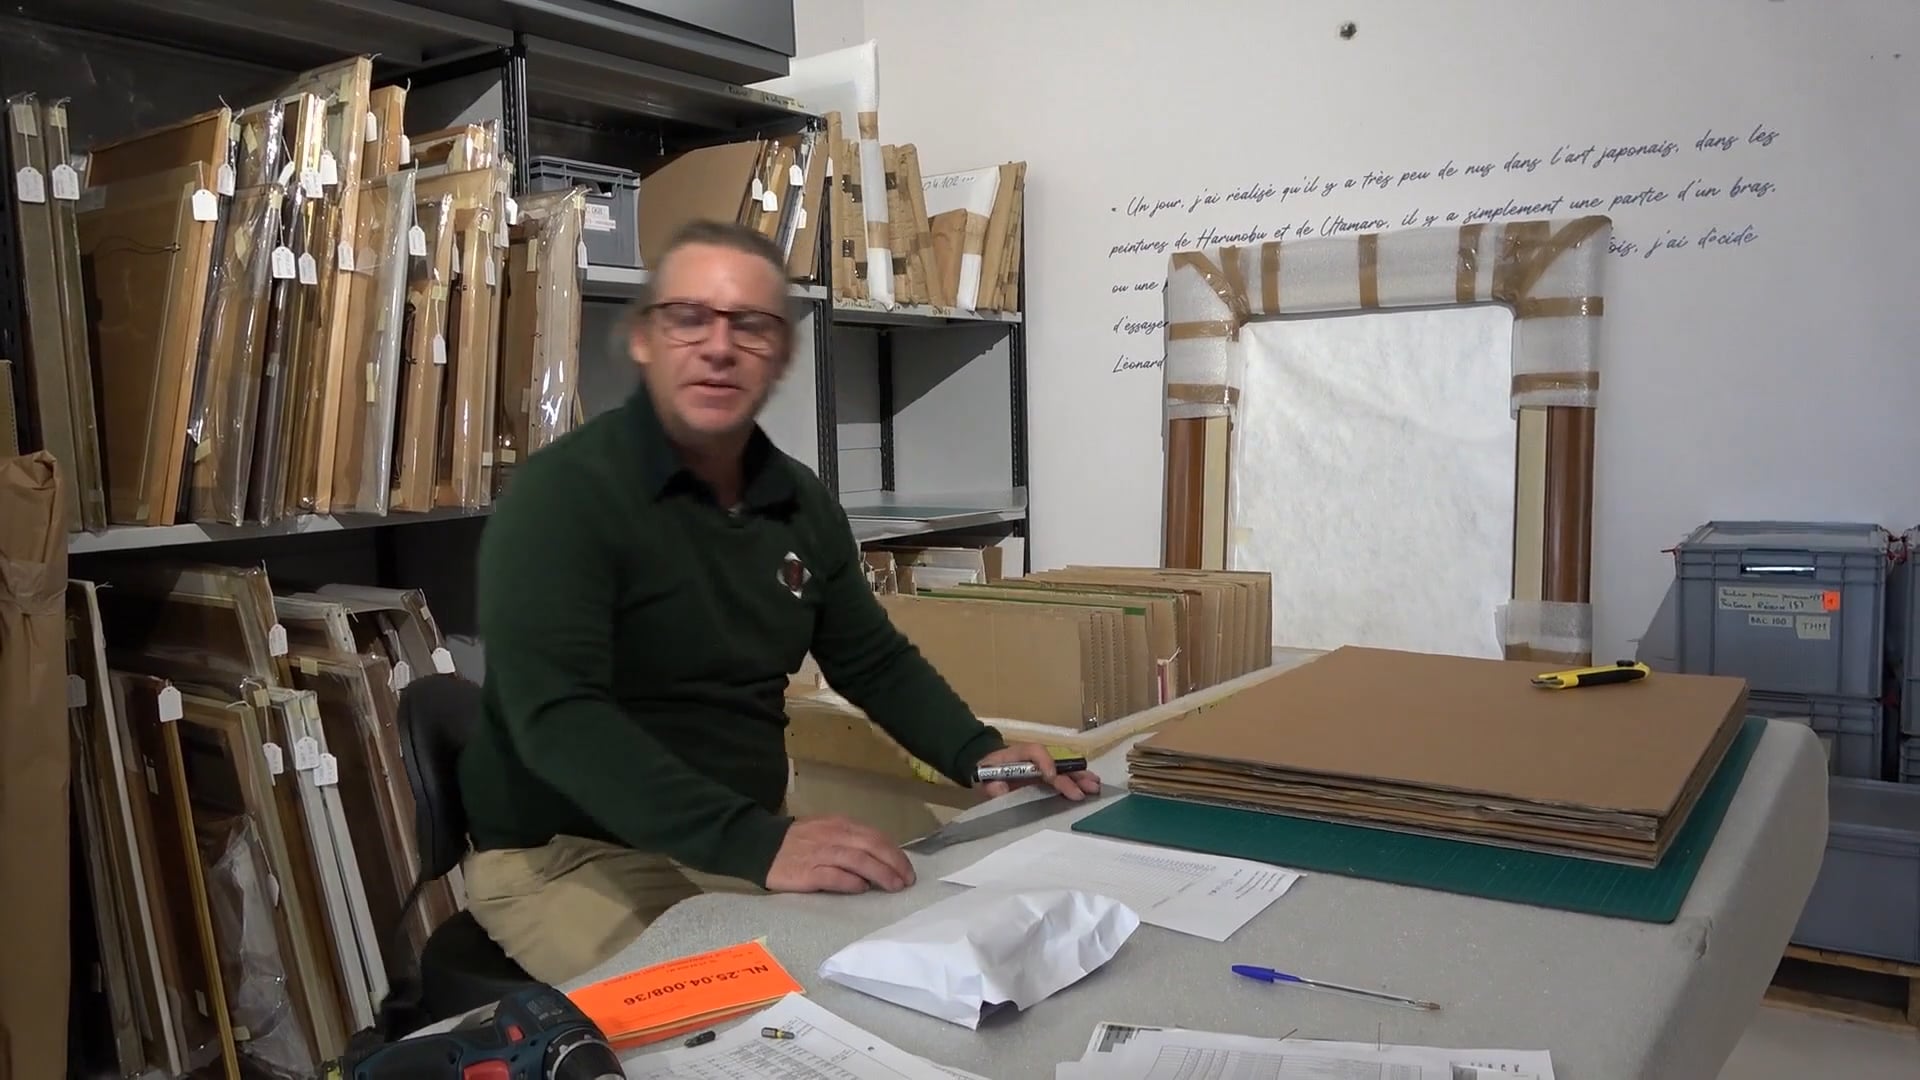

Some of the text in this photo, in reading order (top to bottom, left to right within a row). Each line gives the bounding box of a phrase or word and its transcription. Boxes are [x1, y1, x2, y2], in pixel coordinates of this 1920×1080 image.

[1127, 196, 1150, 217] Un
[1188, 187, 1221, 213] j'ai
[1226, 182, 1277, 203] réalisé
[1281, 176, 1321, 203] qu'il
[1321, 182, 1338, 197] y
[1344, 179, 1357, 189] a
[1361, 170, 1395, 189] très
[1397, 171, 1431, 187] peu
[1437, 160, 1459, 180] de
[1464, 163, 1496, 178] nus
[1503, 151, 1543, 173] dans
[1549, 144, 1596, 169] l'art
[1695, 129, 1739, 151] dans
[1748, 123, 1780, 147] les
[1108, 238, 1169, 259] peintures
[1174, 231, 1192, 248] de
[1197, 225, 1268, 249] Harunobu
[1273, 223, 1292, 240] et
[1295, 219, 1314, 239] de
[1401, 208, 1420, 227] il
[1421, 215, 1440, 228] y
[1445, 212, 1460, 222] a
[1462, 195, 1564, 224] simplement
[1569, 197, 1604, 210] une
[1607, 187, 1668, 212] partie
[1677, 178, 1721, 201] d'un
[1111, 284, 1129, 294] ou
[1134, 281, 1159, 291] une
[1608, 238, 1638, 258] ois,
[1643, 230, 1690, 259] j'ai
[1697, 225, 1759, 249] décidé
[1112, 315, 1169, 335] d'essayer
[1112, 354, 1168, 374] Léonard
[623, 964, 769, 1006] NL.25.04.008/36
